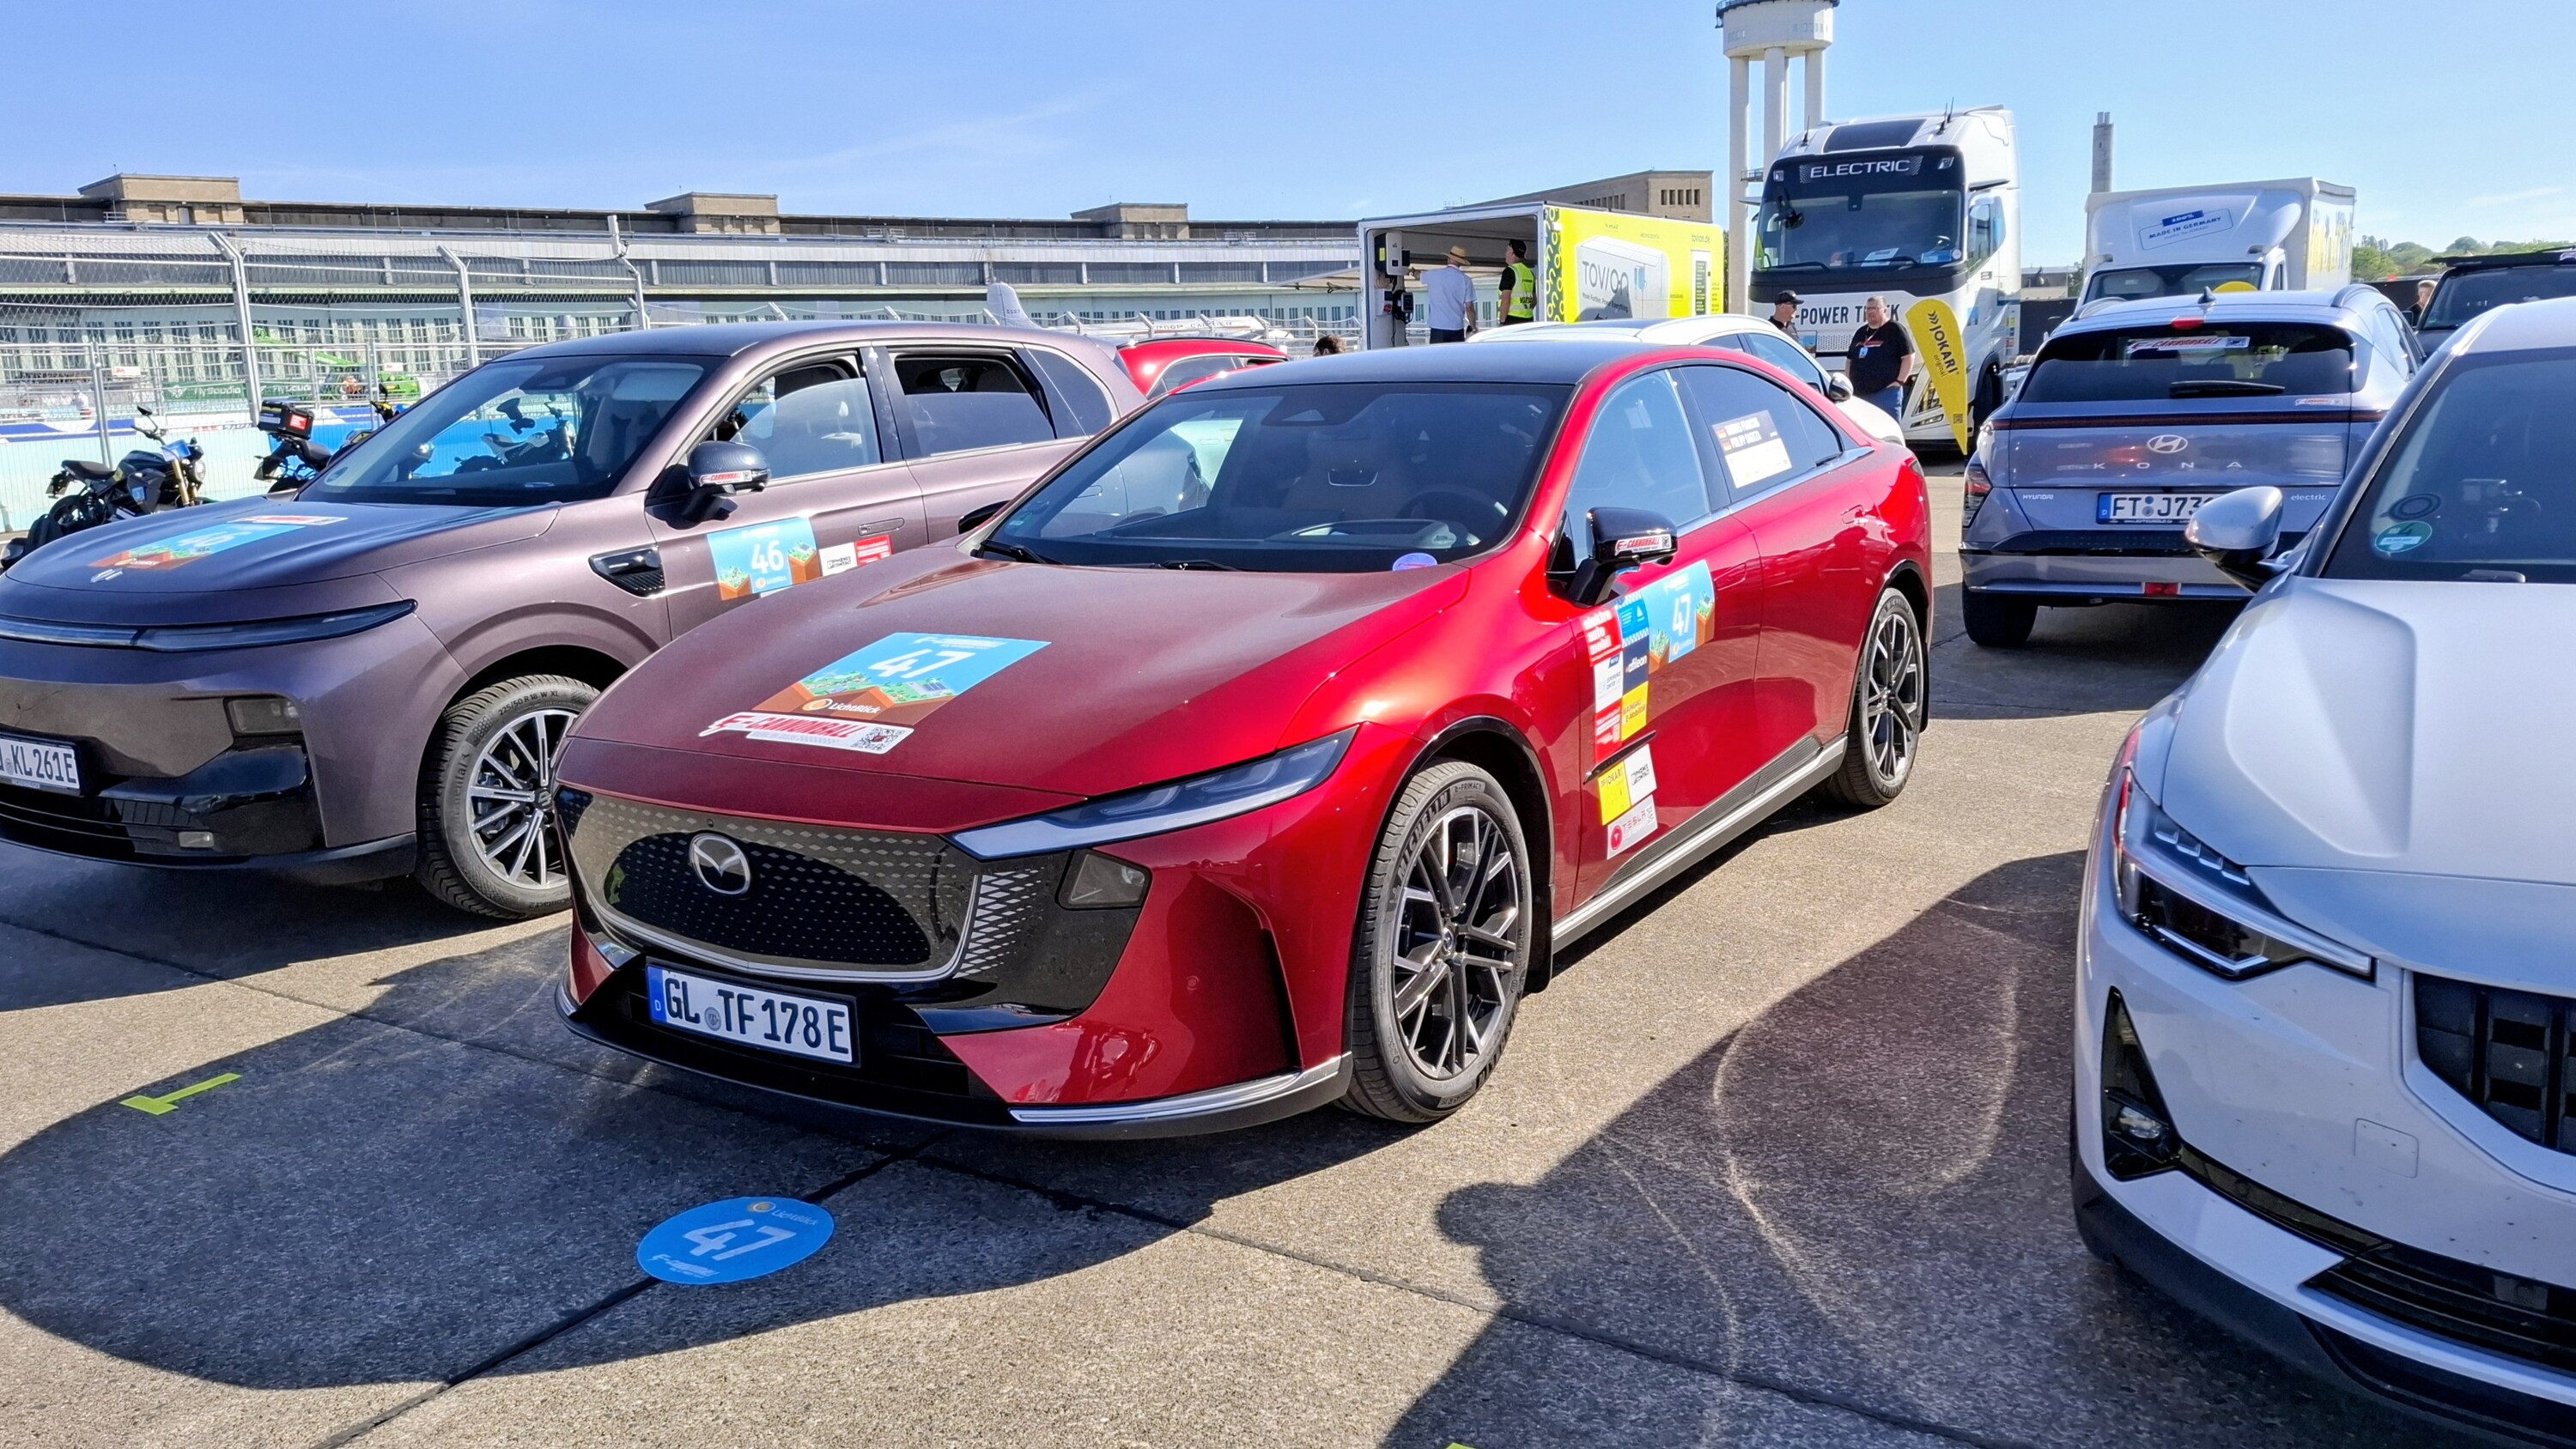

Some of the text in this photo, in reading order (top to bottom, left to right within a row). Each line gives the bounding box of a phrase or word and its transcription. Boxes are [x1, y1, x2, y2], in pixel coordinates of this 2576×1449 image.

[1810, 160, 1910, 178] ELECTRIC
[2148, 229, 2171, 239] MADE
[2183, 216, 2222, 230] GERMANY
[1792, 306, 1849, 325] -POWER
[2113, 497, 2140, 516] FT
[751, 540, 784, 573] 46
[1583, 609, 1612, 630] elektro
[1673, 592, 1691, 636] 47
[867, 649, 975, 678] 47
[498, 698, 524, 716] 225/50
[829, 702, 881, 714] LichtBlick
[1397, 788, 1451, 881] MICHELIN
[665, 978, 701, 1025] GL
[771, 1209, 819, 1227] LichtBlick
[683, 1219, 798, 1262] 47
